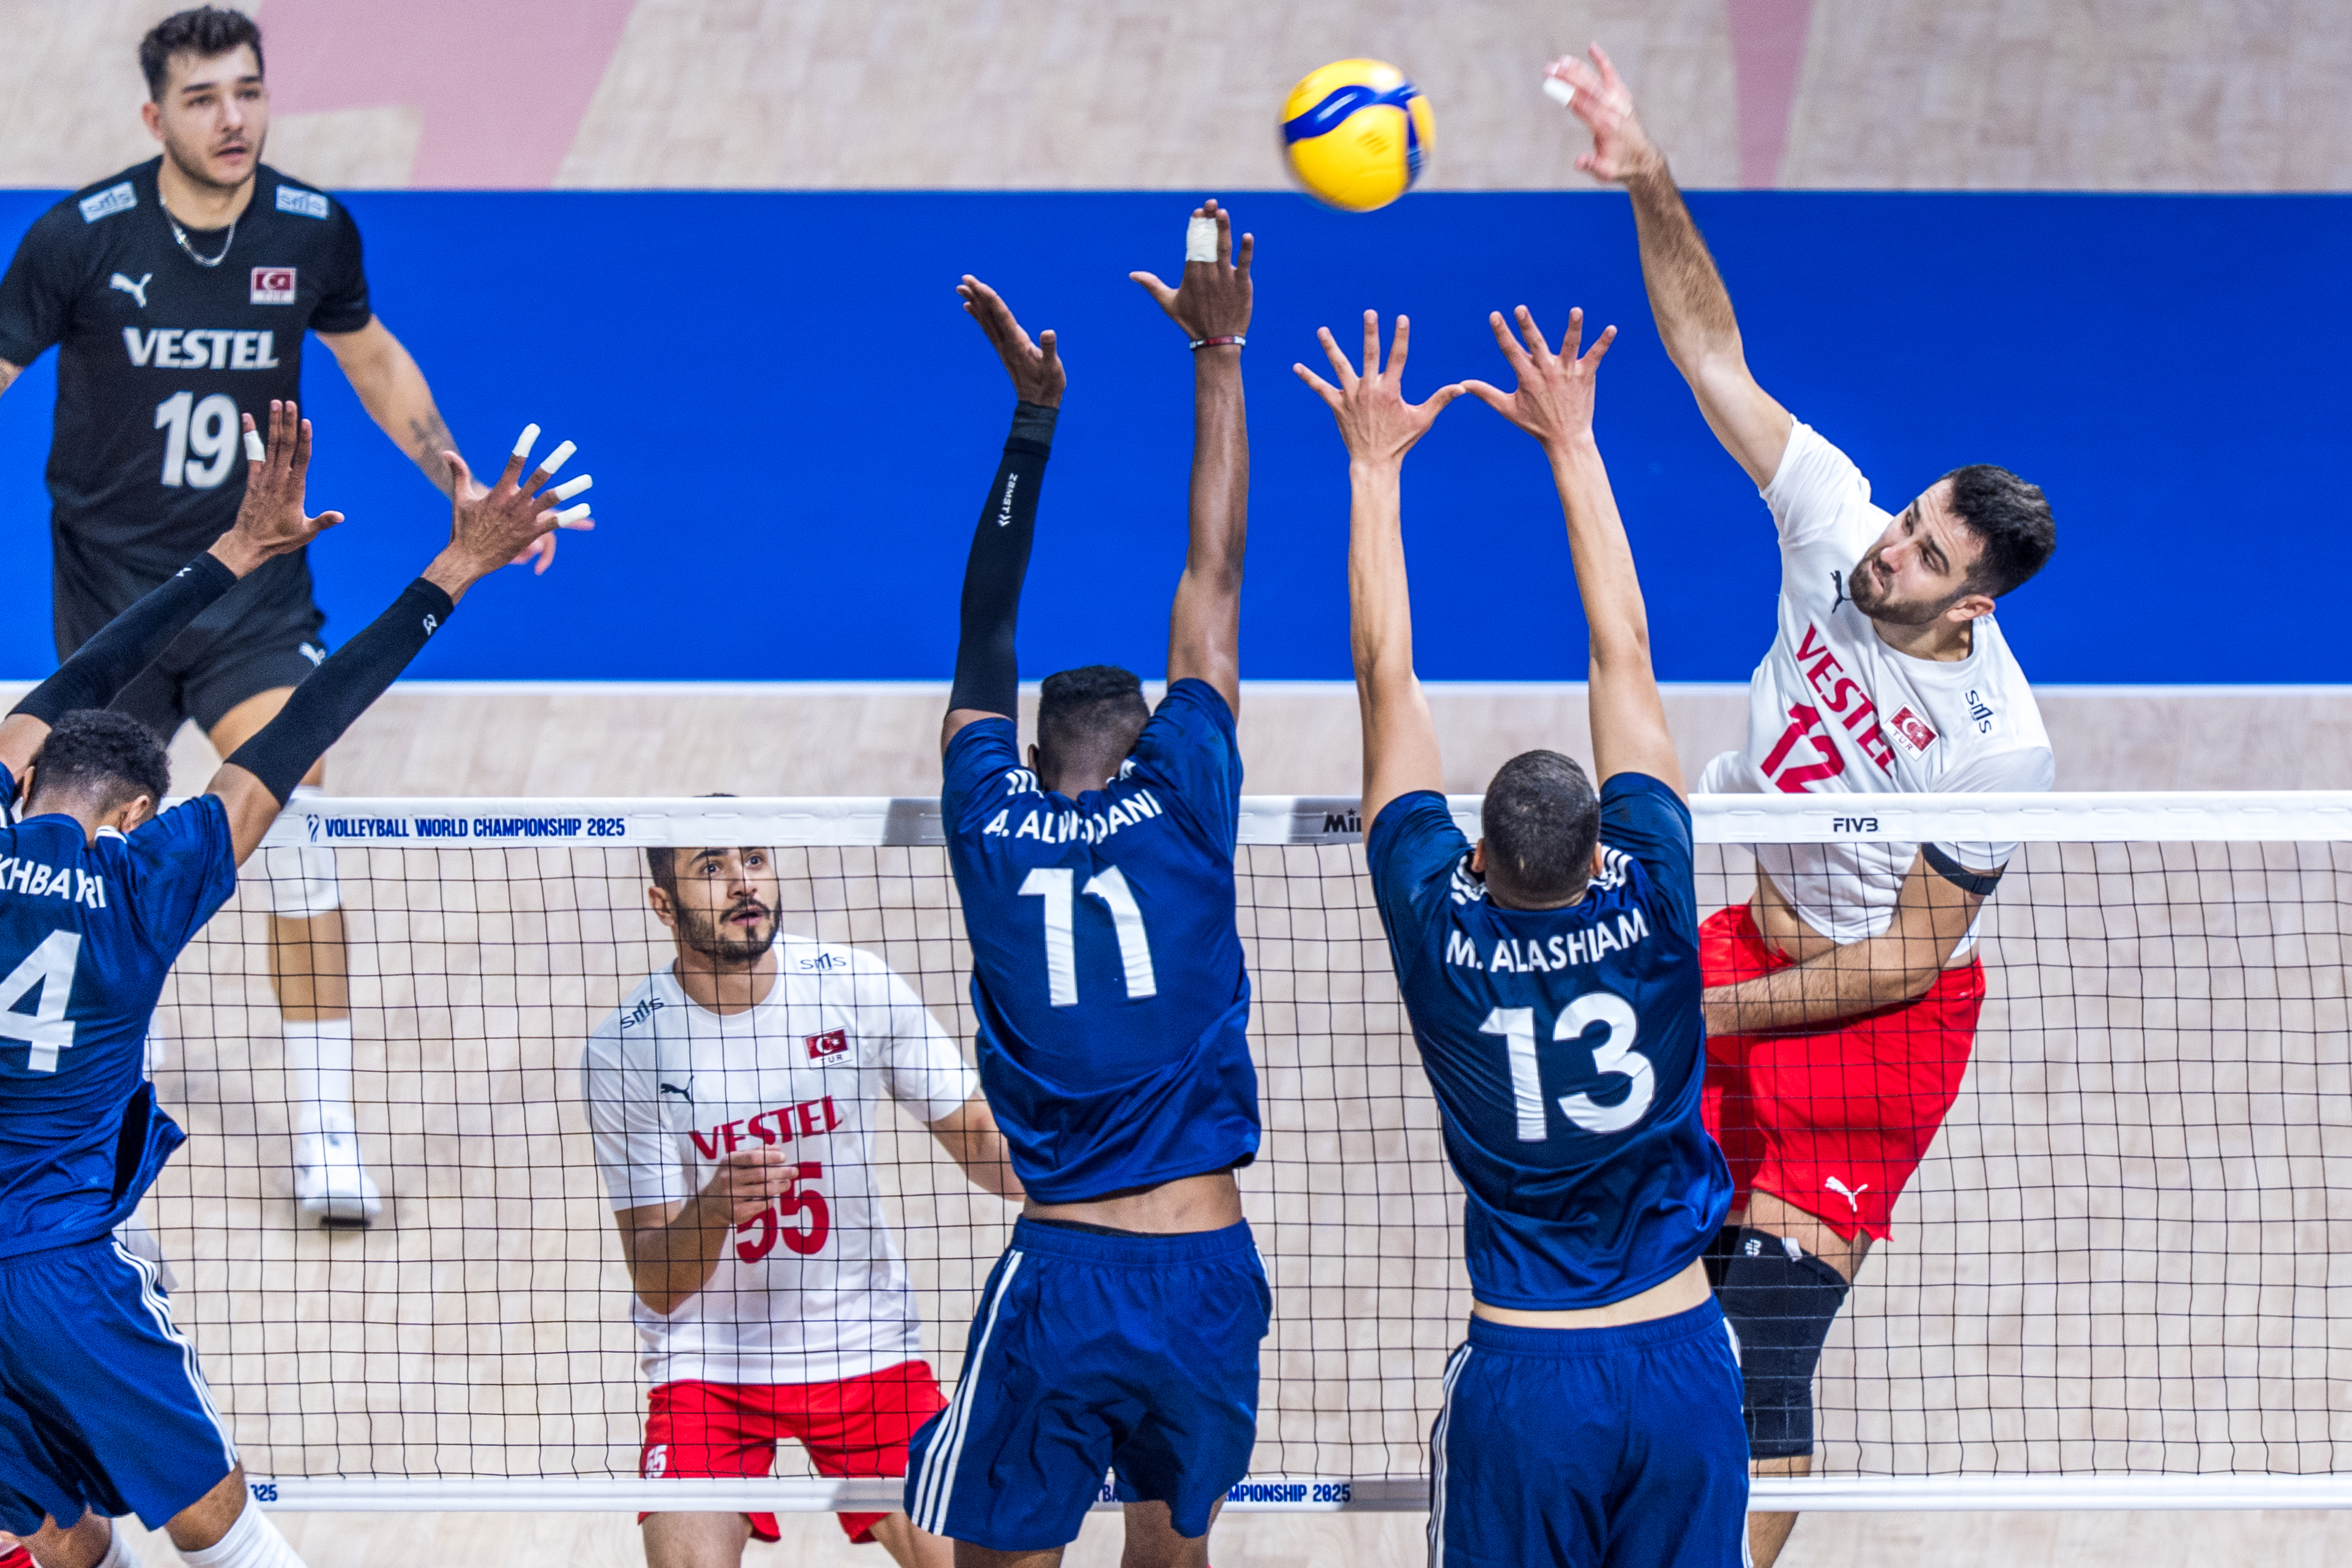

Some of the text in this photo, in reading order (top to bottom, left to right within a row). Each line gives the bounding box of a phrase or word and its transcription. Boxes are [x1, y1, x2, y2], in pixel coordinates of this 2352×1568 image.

[122, 327, 280, 370] VESTEL
[155, 390, 239, 489] 19
[1796, 622, 1896, 779] VESTEL
[1893, 729, 1913, 751] TUR
[325, 818, 625, 837] VOLLEYBALL WORLD CHAMPIONSHIP 2025
[983, 809, 1010, 838] A.
[1833, 818, 1878, 833] FIVB
[1018, 864, 1157, 1007] 11
[1446, 930, 1484, 970] M.
[0, 929, 81, 1072] 4
[1478, 991, 1655, 1143] 13
[688, 1095, 843, 1160] VESTEL
[1313, 1484, 1352, 1503] 2025
